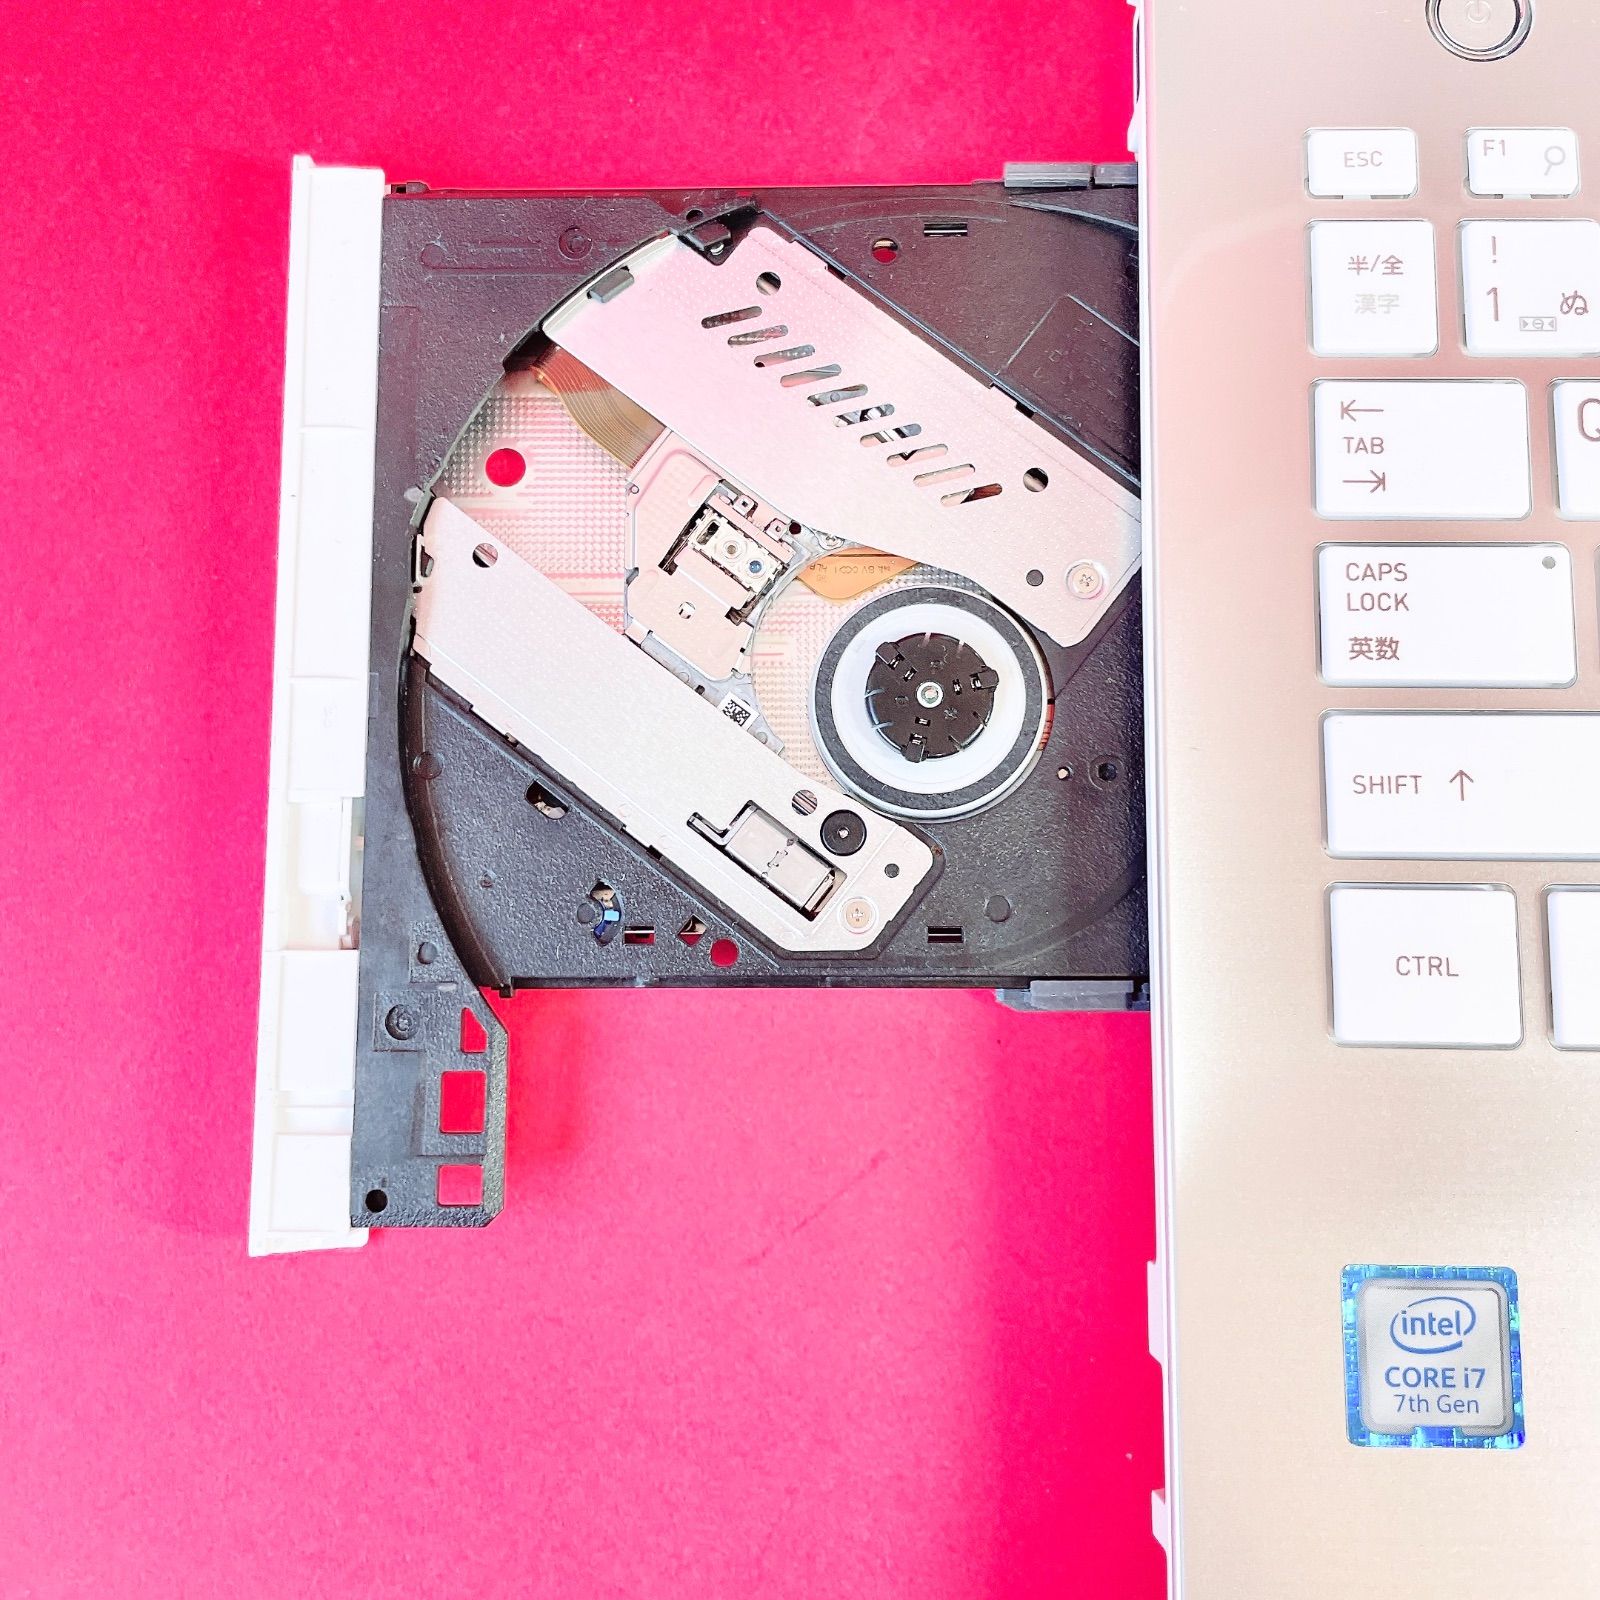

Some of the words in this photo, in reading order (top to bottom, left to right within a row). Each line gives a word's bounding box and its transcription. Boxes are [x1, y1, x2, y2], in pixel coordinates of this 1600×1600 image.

[1483, 139, 1506, 157] F1
[1344, 151, 1382, 167] ESC
[1491, 236, 1497, 264] !
[1348, 255, 1403, 275] 半/全
[1355, 293, 1400, 314] 漢字
[1487, 287, 1499, 321] 1
[1560, 290, 1589, 315] ぬ
[1344, 437, 1384, 454] TAB
[1346, 563, 1407, 581] CAPS
[1347, 593, 1409, 611] LOCK
[1349, 637, 1399, 660] 英数
[1353, 775, 1422, 794] SHIFT
[1396, 956, 1459, 976] CTRL
[1401, 1310, 1461, 1336] intel
[1385, 1367, 1456, 1388] CORE
[1464, 1367, 1486, 1388] i7
[1394, 1394, 1429, 1413] 7th
[1437, 1394, 1479, 1413] Gen
